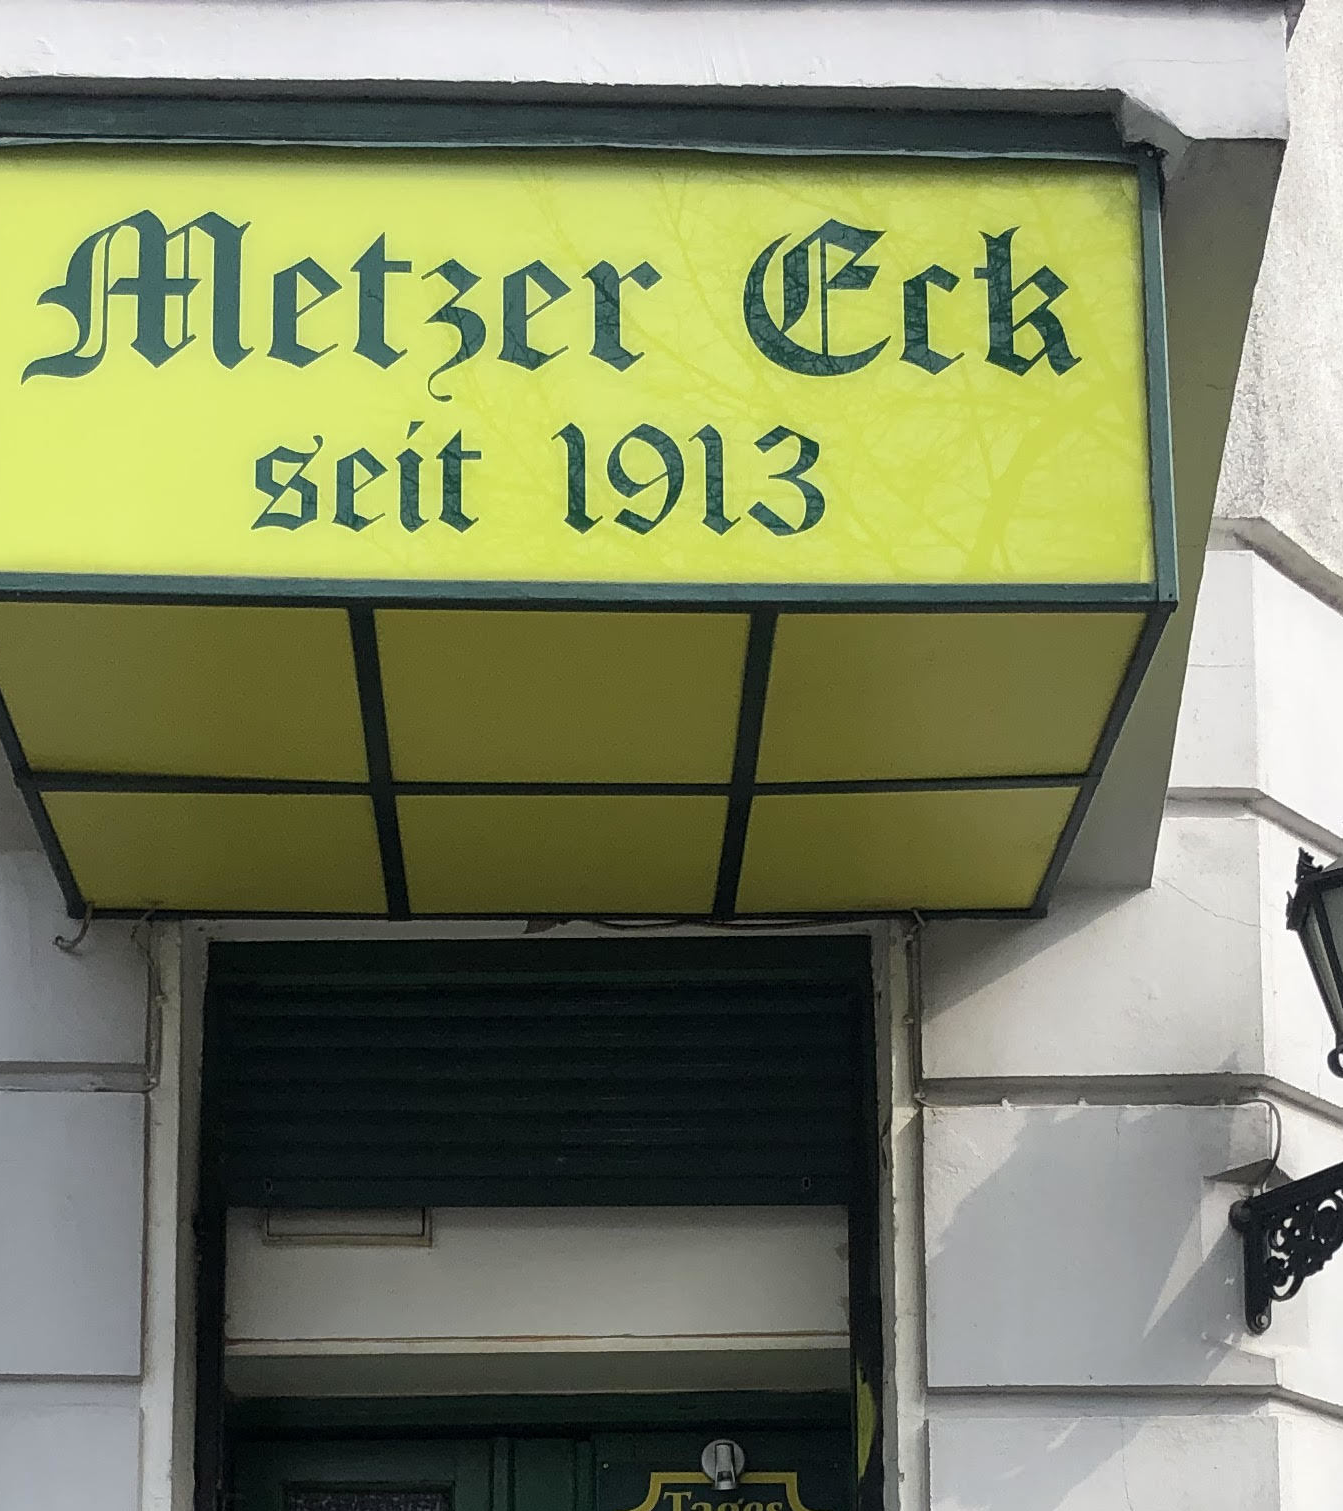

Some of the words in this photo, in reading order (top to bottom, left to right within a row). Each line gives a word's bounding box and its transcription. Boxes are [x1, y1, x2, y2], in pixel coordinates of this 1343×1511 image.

[19, 207, 664, 402] Metzer
[742, 217, 1083, 380] Eck
[250, 419, 483, 533] seit
[551, 421, 828, 538] 1913
